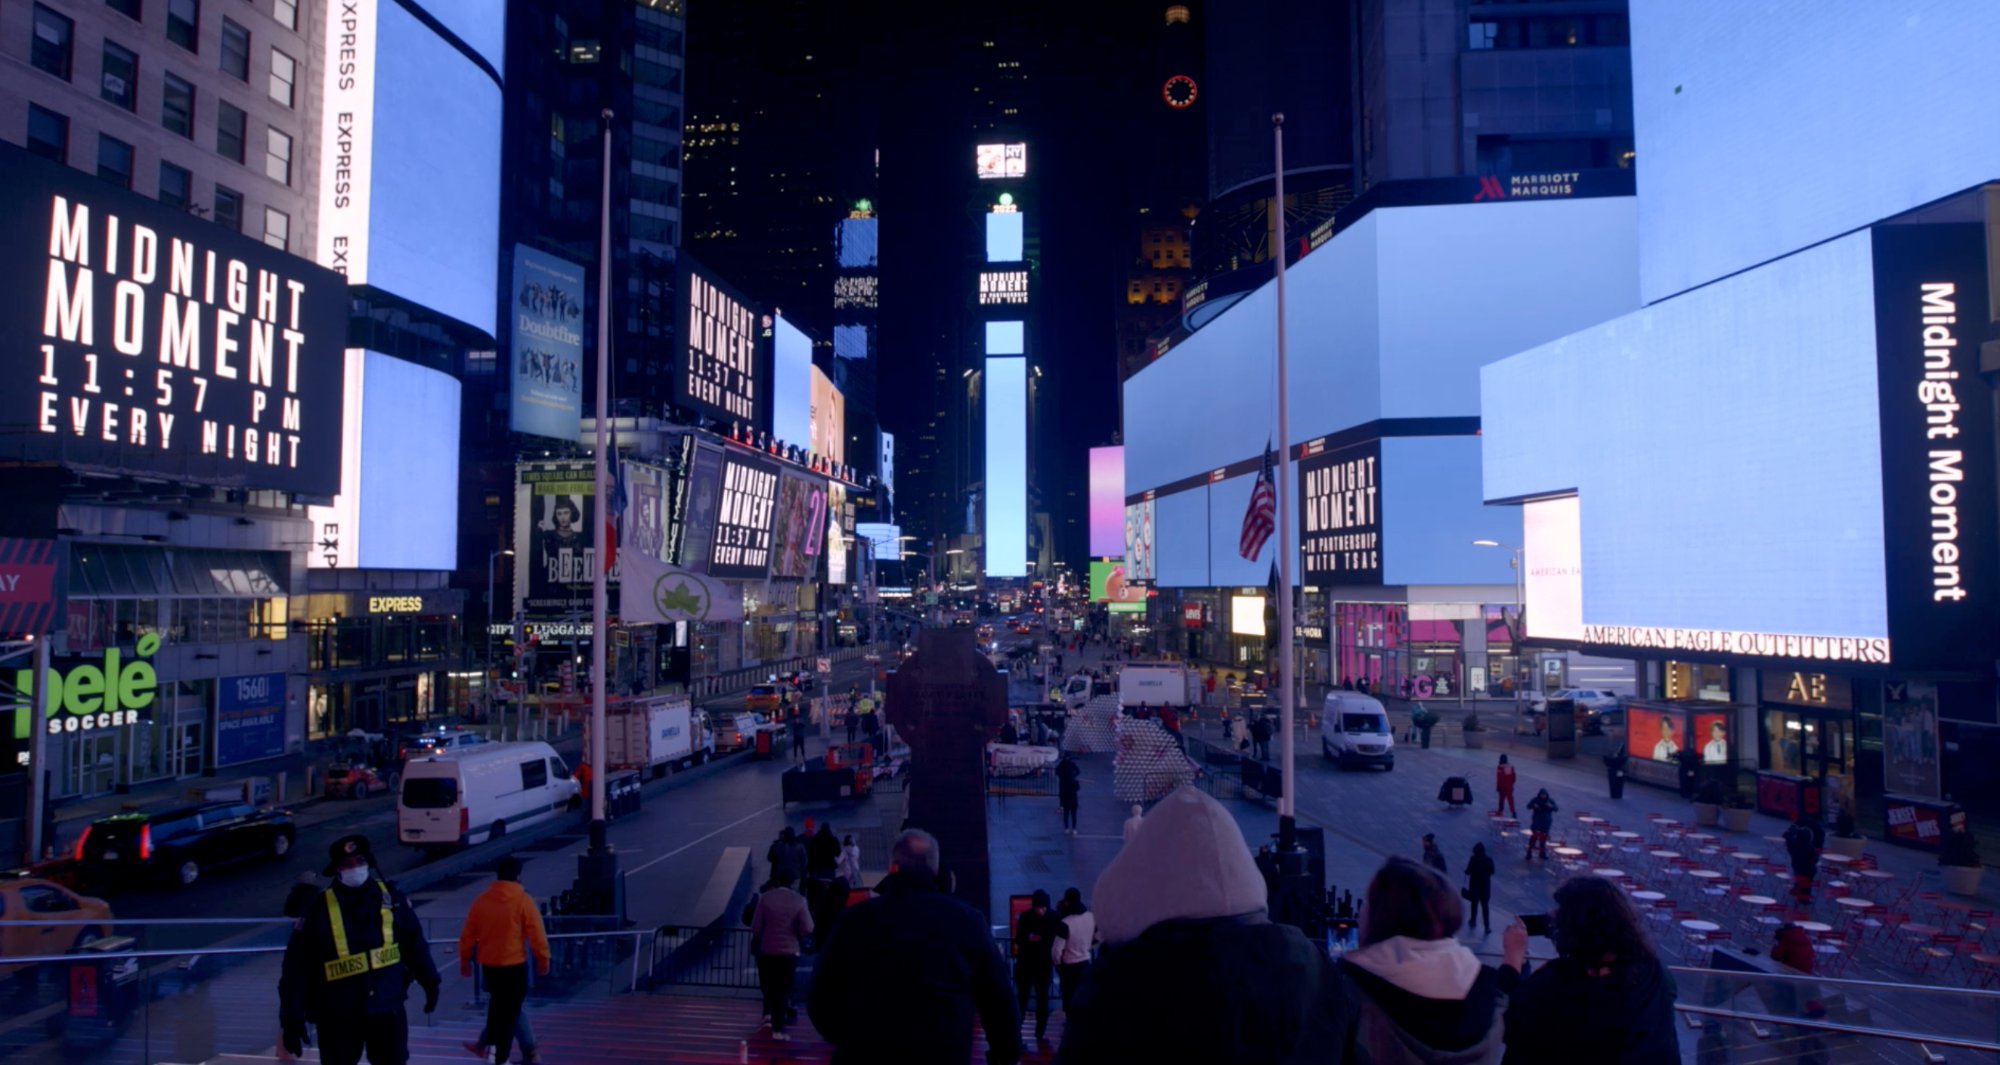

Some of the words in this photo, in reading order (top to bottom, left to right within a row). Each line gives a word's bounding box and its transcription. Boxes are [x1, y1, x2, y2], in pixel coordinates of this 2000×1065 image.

[339, 0, 357, 91] XPRESS
[335, 112, 353, 209] EXPRESS
[1511, 173, 1580, 185] MARRIOTT
[1511, 185, 1572, 196] MARQUIS
[50, 194, 305, 331] MIDNIGHT
[980, 280, 1028, 292] MOMENT
[43, 257, 305, 394] MOMENT
[690, 272, 755, 342] MIDNIGHT
[519, 314, 581, 347] Doubtfire
[689, 304, 755, 378] MOMENT
[689, 349, 729, 387] 11:57
[738, 373, 754, 399] PM
[1918, 283, 1961, 439] Midnight
[39, 344, 208, 413] 11:57
[252, 389, 301, 432] PM
[688, 372, 721, 407] EVERY
[725, 390, 754, 420] NIGHT
[39, 391, 175, 450] EVERY
[201, 419, 301, 469] NIGHT
[724, 461, 777, 500] MIDNIGHT
[1306, 456, 1375, 498] MIDNIGHT
[720, 488, 774, 531] MOMENT
[1306, 487, 1376, 532] MOMENT
[1928, 450, 1967, 602] Moment
[716, 525, 750, 546] 11:57
[1306, 538, 1315, 553] IN
[1319, 532, 1377, 553] PARTNERSHIP
[714, 545, 742, 567] EVERY
[744, 549, 768, 567] NIGHT
[1306, 553, 1336, 571] WITH
[1345, 551, 1378, 569] TSAC
[369, 596, 423, 613] EXPRESS
[533, 625, 594, 636] LUGGAGE
[1583, 625, 1668, 649] AMERICAN
[1673, 629, 1733, 653] EAGLE
[1738, 632, 1887, 663] OUTFITTERS
[14, 632, 161, 739] pelé
[236, 676, 267, 701] 1560
[1787, 671, 1827, 702] AE
[48, 709, 139, 734] SOCCER
[220, 721, 241, 731] SPACE
[328, 957, 364, 978] TIMES
